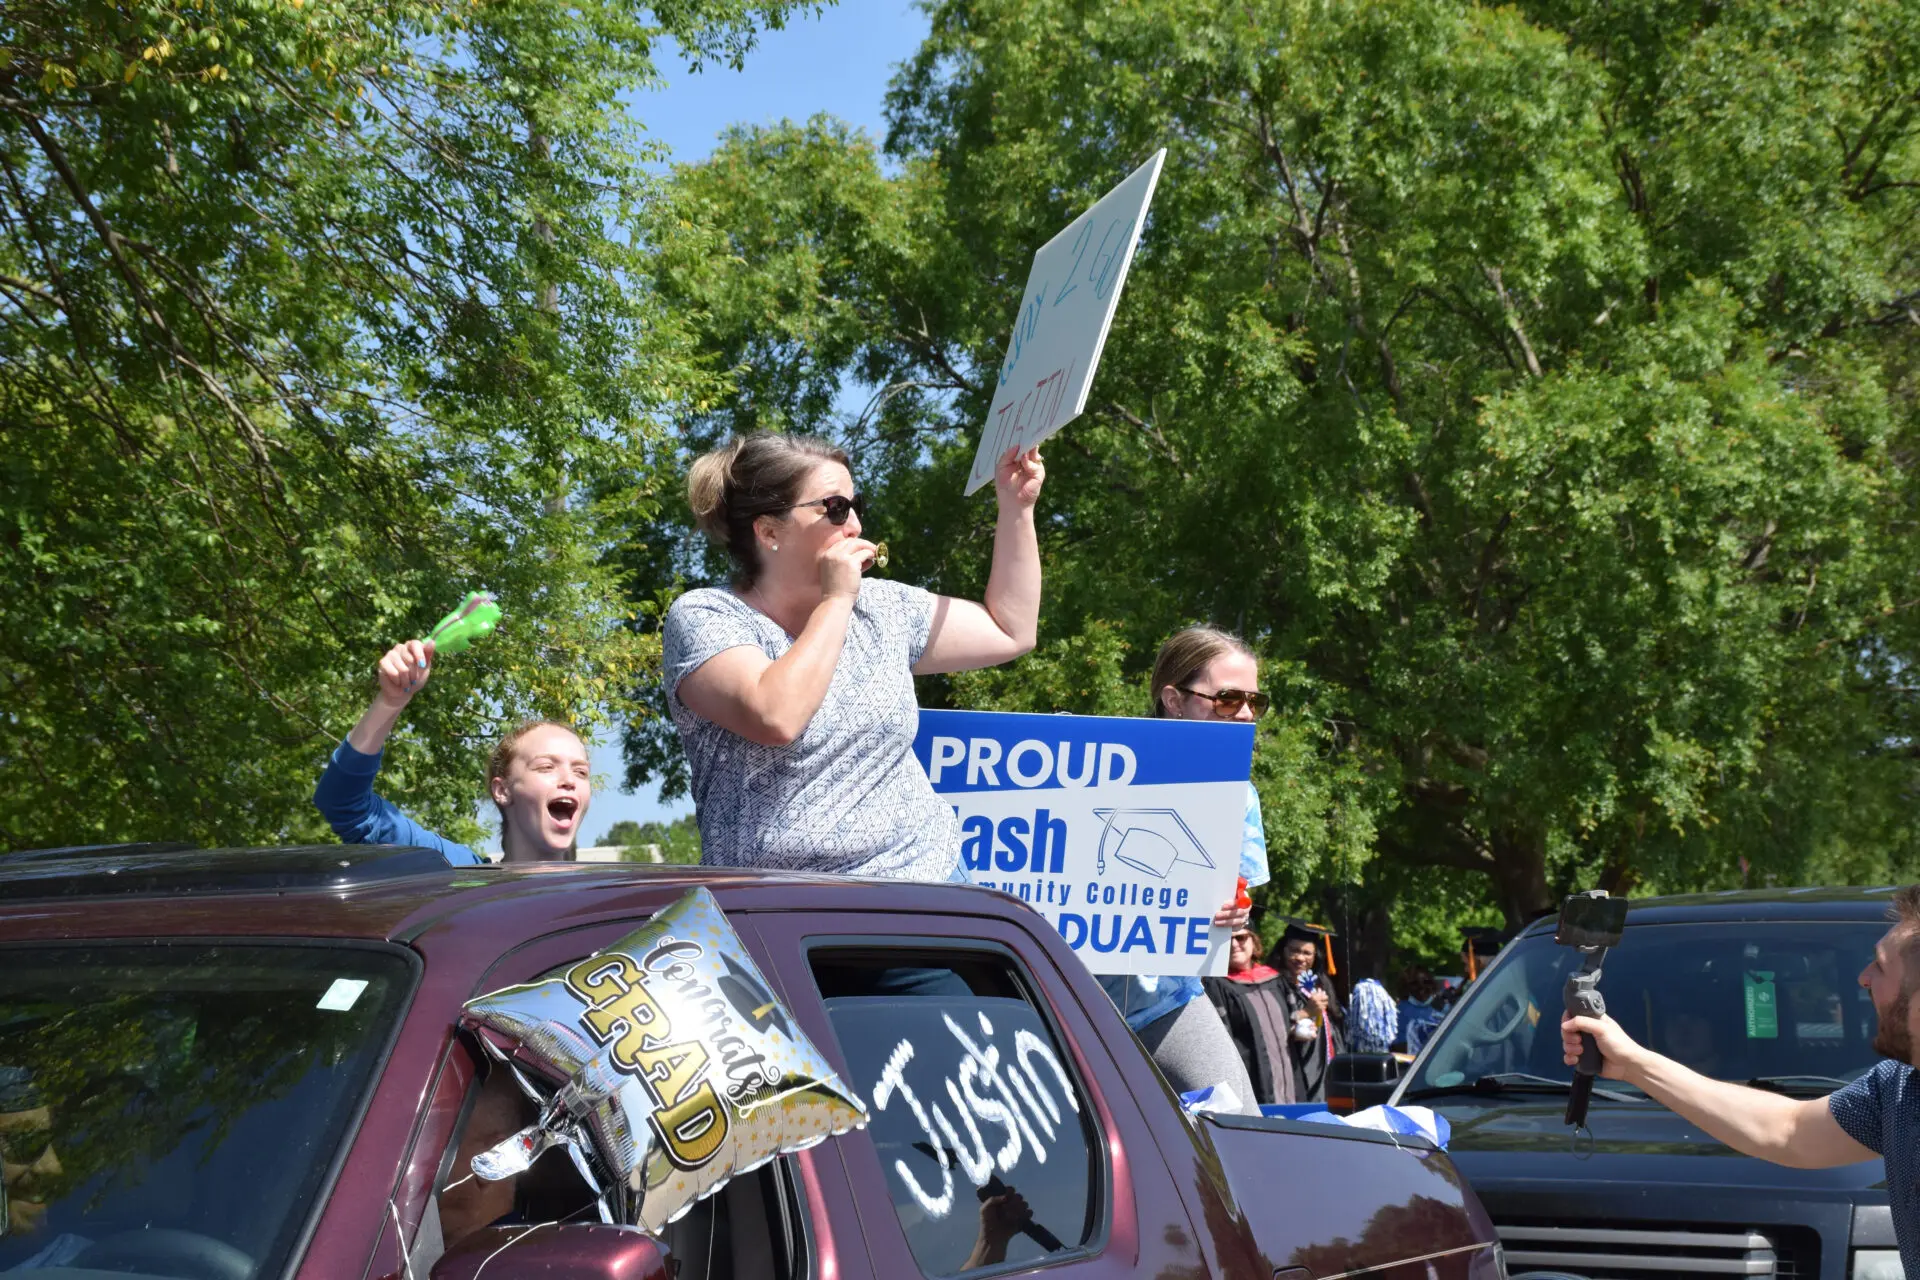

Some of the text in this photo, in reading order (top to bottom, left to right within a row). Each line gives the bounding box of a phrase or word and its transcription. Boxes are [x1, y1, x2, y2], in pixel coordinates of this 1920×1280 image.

[1053, 219, 1093, 307] 2
[930, 736, 1137, 788] PROUD
[952, 806, 1067, 873] ash
[1086, 881, 1189, 909] College
[1041, 912, 1210, 955] DUATE
[644, 936, 781, 1099] Congrats
[564, 952, 731, 1171] GRAD
